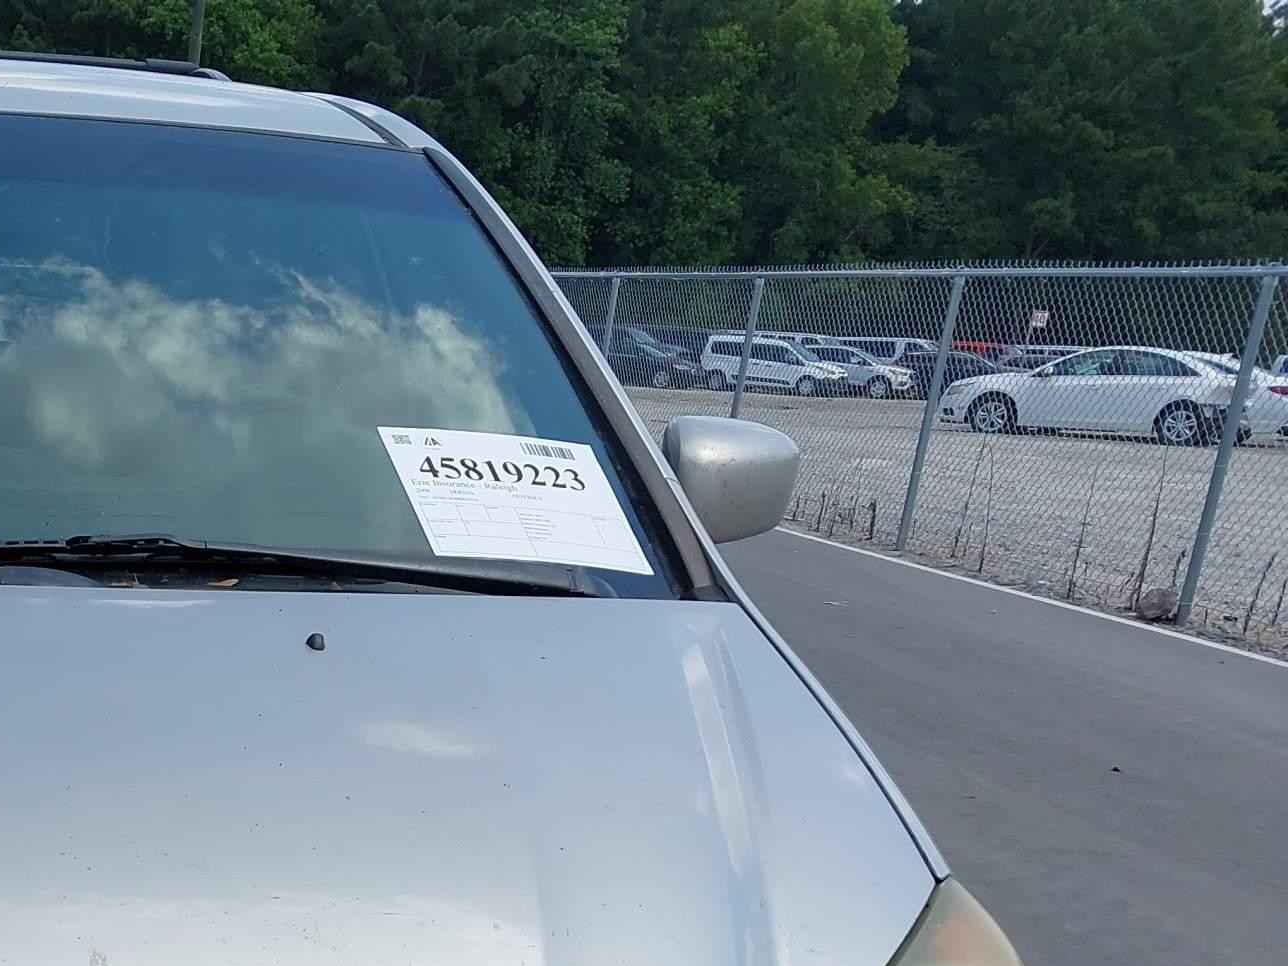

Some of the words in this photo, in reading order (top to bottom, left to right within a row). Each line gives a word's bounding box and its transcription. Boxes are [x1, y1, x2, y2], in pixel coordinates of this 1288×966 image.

[411, 478, 430, 486] Erie
[433, 478, 476, 489] Insurance
[484, 482, 518, 492] Raleigh
[419, 456, 586, 491] 45819223
